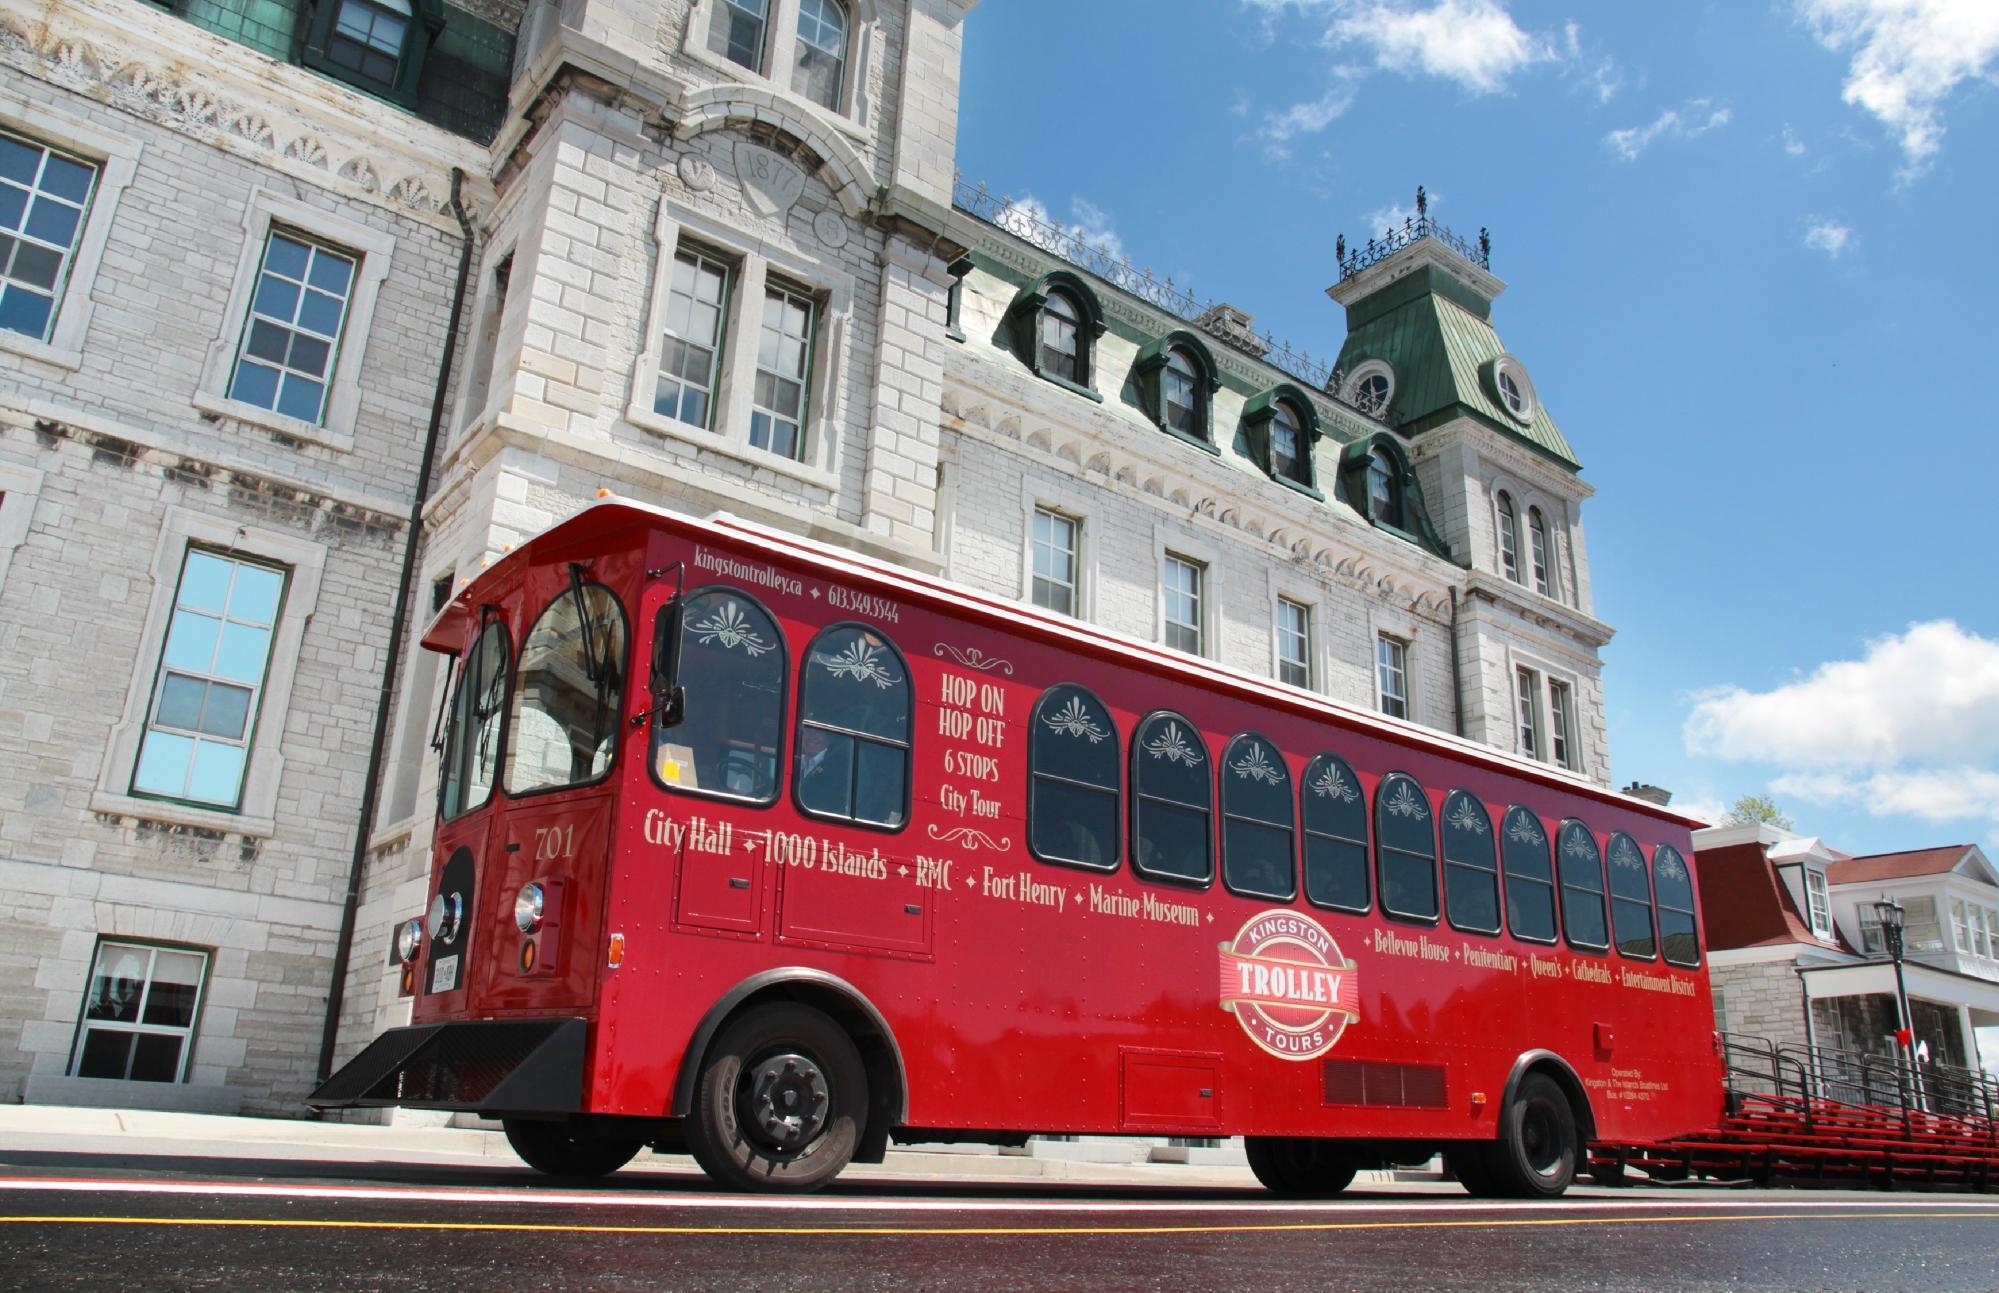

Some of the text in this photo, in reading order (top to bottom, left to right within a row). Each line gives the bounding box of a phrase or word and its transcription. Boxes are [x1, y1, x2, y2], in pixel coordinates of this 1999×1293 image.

[745, 150, 798, 191] 1877
[693, 545, 899, 624] kingstontrolley.ca 613.549.5544
[941, 673, 1005, 717] HOP ON
[938, 707, 1006, 749] HOP OFF
[944, 749, 999, 782] 6 STOPS
[940, 784, 1002, 819] City Tour
[535, 824, 574, 861] 701
[644, 808, 1199, 927] City Hall 1000 Islands RMC Fort Henry Marine Museum
[1249, 918, 1329, 954] KINGSTON
[1237, 962, 1341, 1004] TROLLEY
[1374, 928, 1696, 997] Bellevue House Penitentiary Queen's Cathedrals Entertainment District
[1265, 1027, 1323, 1051] TOURS
